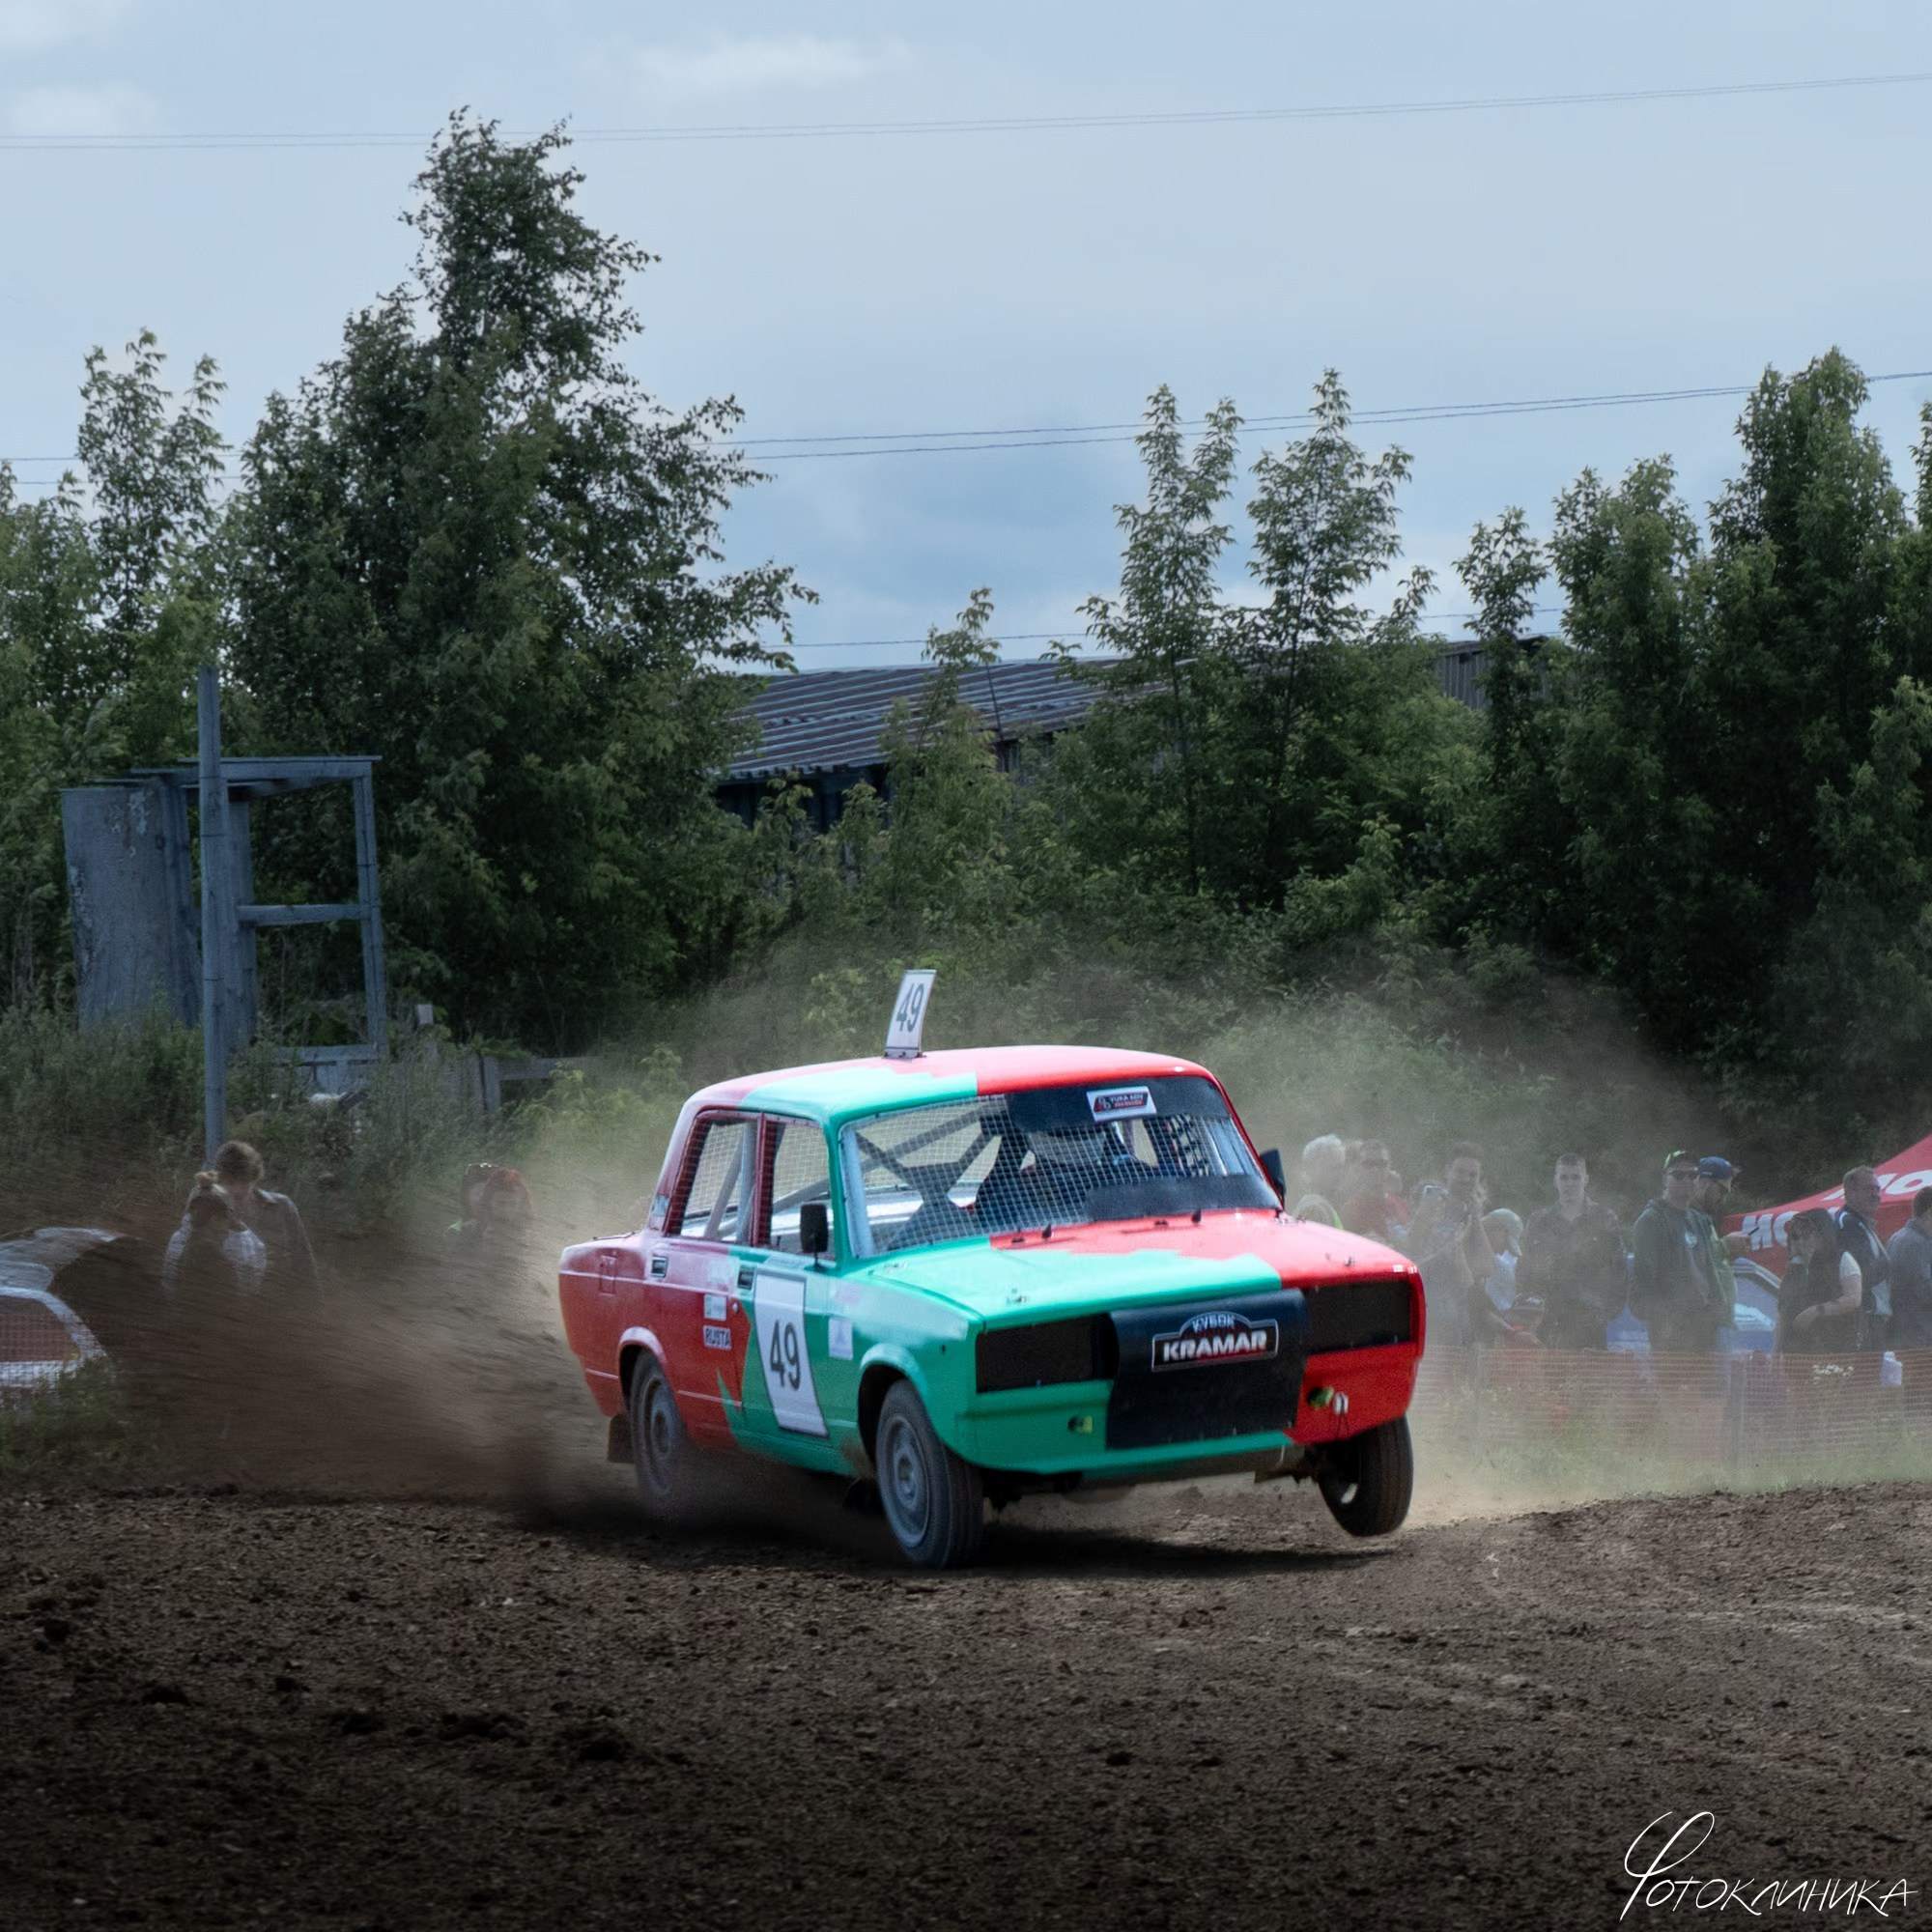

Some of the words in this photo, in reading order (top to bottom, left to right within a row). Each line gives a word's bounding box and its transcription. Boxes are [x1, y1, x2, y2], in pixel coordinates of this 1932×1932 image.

[895, 982, 924, 1033] 49
[770, 1320, 801, 1391] 49
[1163, 1329, 1267, 1363] KRAMAR
